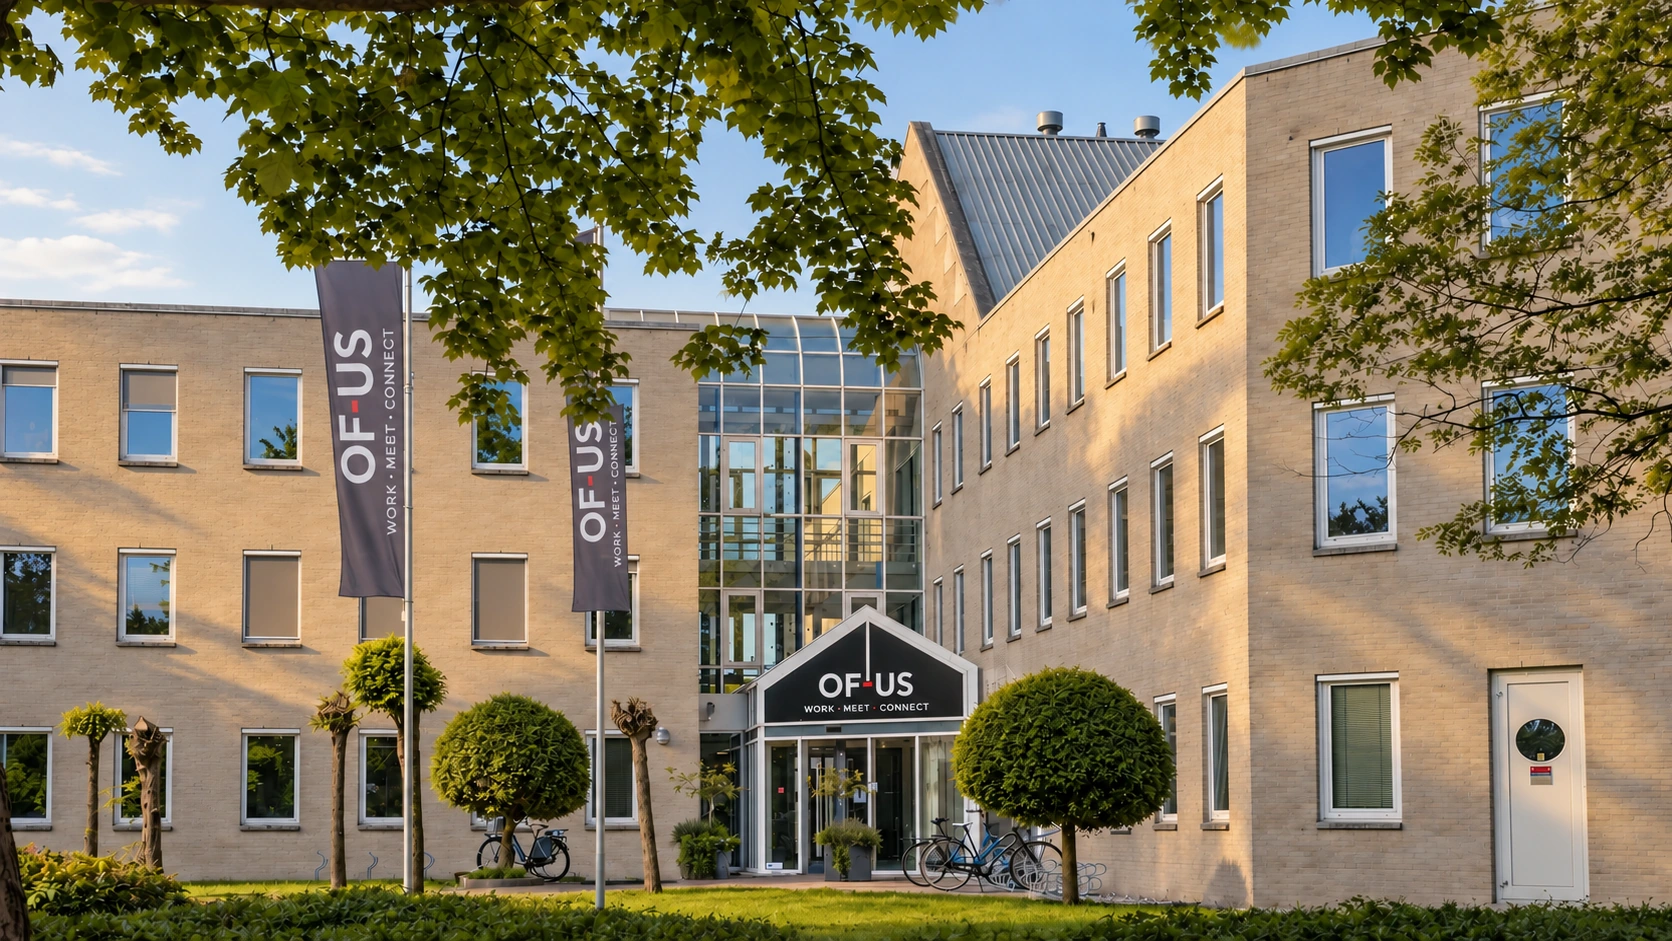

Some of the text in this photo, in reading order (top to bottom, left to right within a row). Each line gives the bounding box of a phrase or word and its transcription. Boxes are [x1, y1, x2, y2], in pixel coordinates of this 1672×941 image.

[382, 328, 396, 410] CONNECT
[334, 329, 375, 484] OF-US
[609, 420, 619, 478] CONNECT
[575, 421, 606, 542] OF-US
[387, 485, 397, 535] WORK
[613, 531, 622, 567] WORK
[804, 703, 930, 713] WORK MEET CONNECT
[818, 672, 914, 698] OF-US
